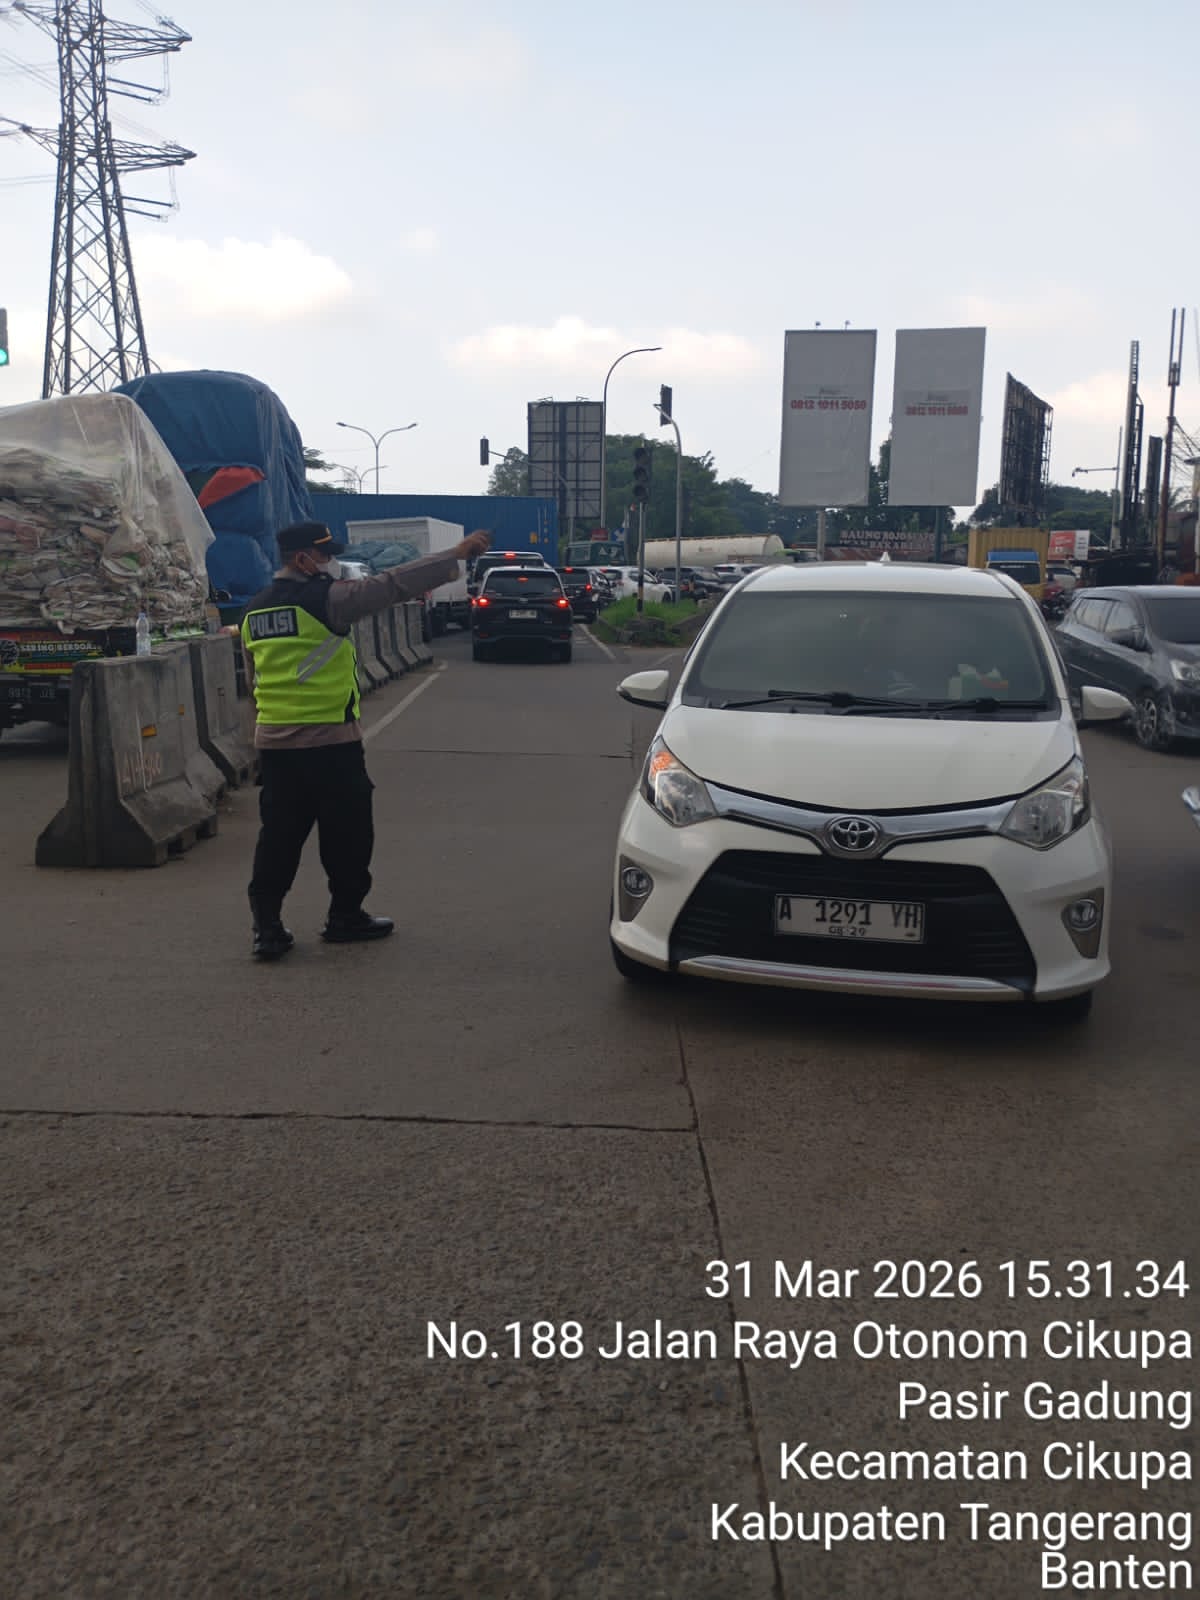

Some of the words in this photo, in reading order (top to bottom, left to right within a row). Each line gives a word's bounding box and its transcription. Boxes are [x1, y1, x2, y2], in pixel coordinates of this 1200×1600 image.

[250, 610, 293, 638] POLISI
[779, 897, 792, 921] A
[815, 899, 872, 926] 1291
[892, 903, 919, 929] YH
